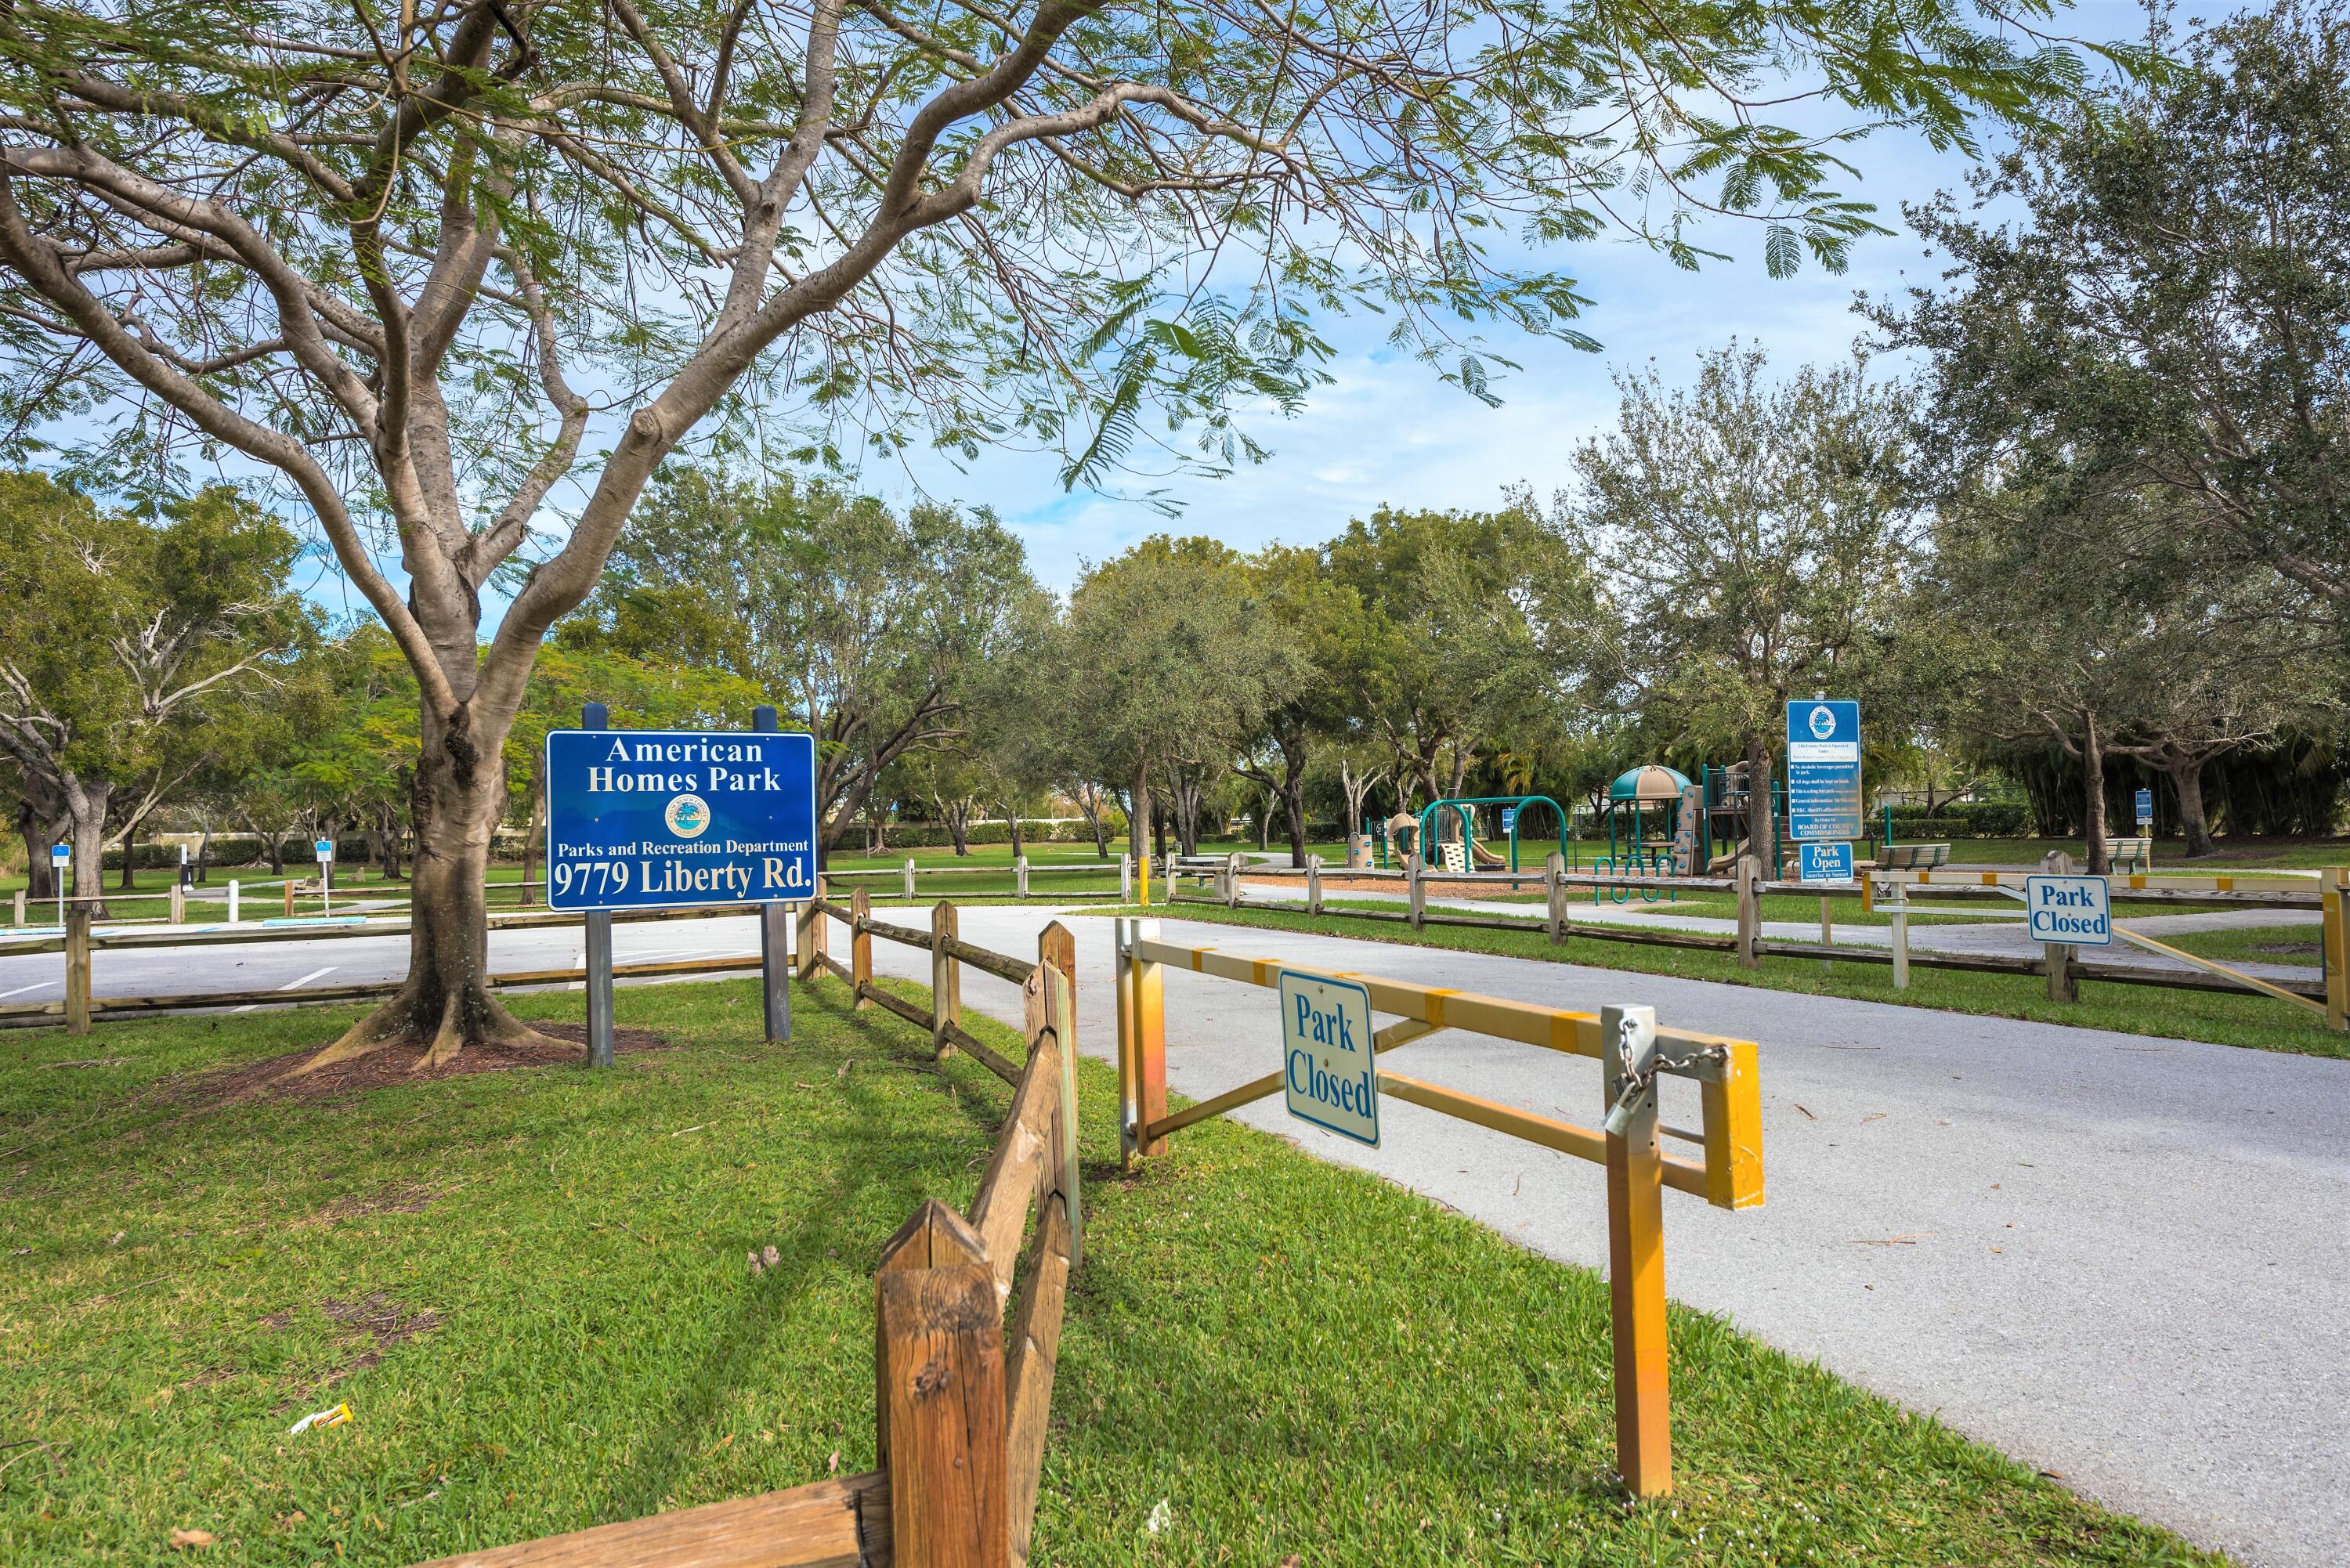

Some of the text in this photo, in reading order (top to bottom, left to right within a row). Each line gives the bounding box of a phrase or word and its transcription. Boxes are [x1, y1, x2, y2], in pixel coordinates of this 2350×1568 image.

[606, 737, 763, 762] American
[588, 767, 782, 792] Homes Park
[558, 840, 808, 858] Parks and Recreation Department
[1813, 846, 1839, 857] Park
[1812, 857, 1841, 871] Open
[555, 857, 812, 898] 9779 Liberty Rd.
[2040, 885, 2095, 907] Park
[2033, 910, 2106, 934] Closed
[1294, 993, 1356, 1053] Park
[1289, 1049, 1372, 1118] Closed
